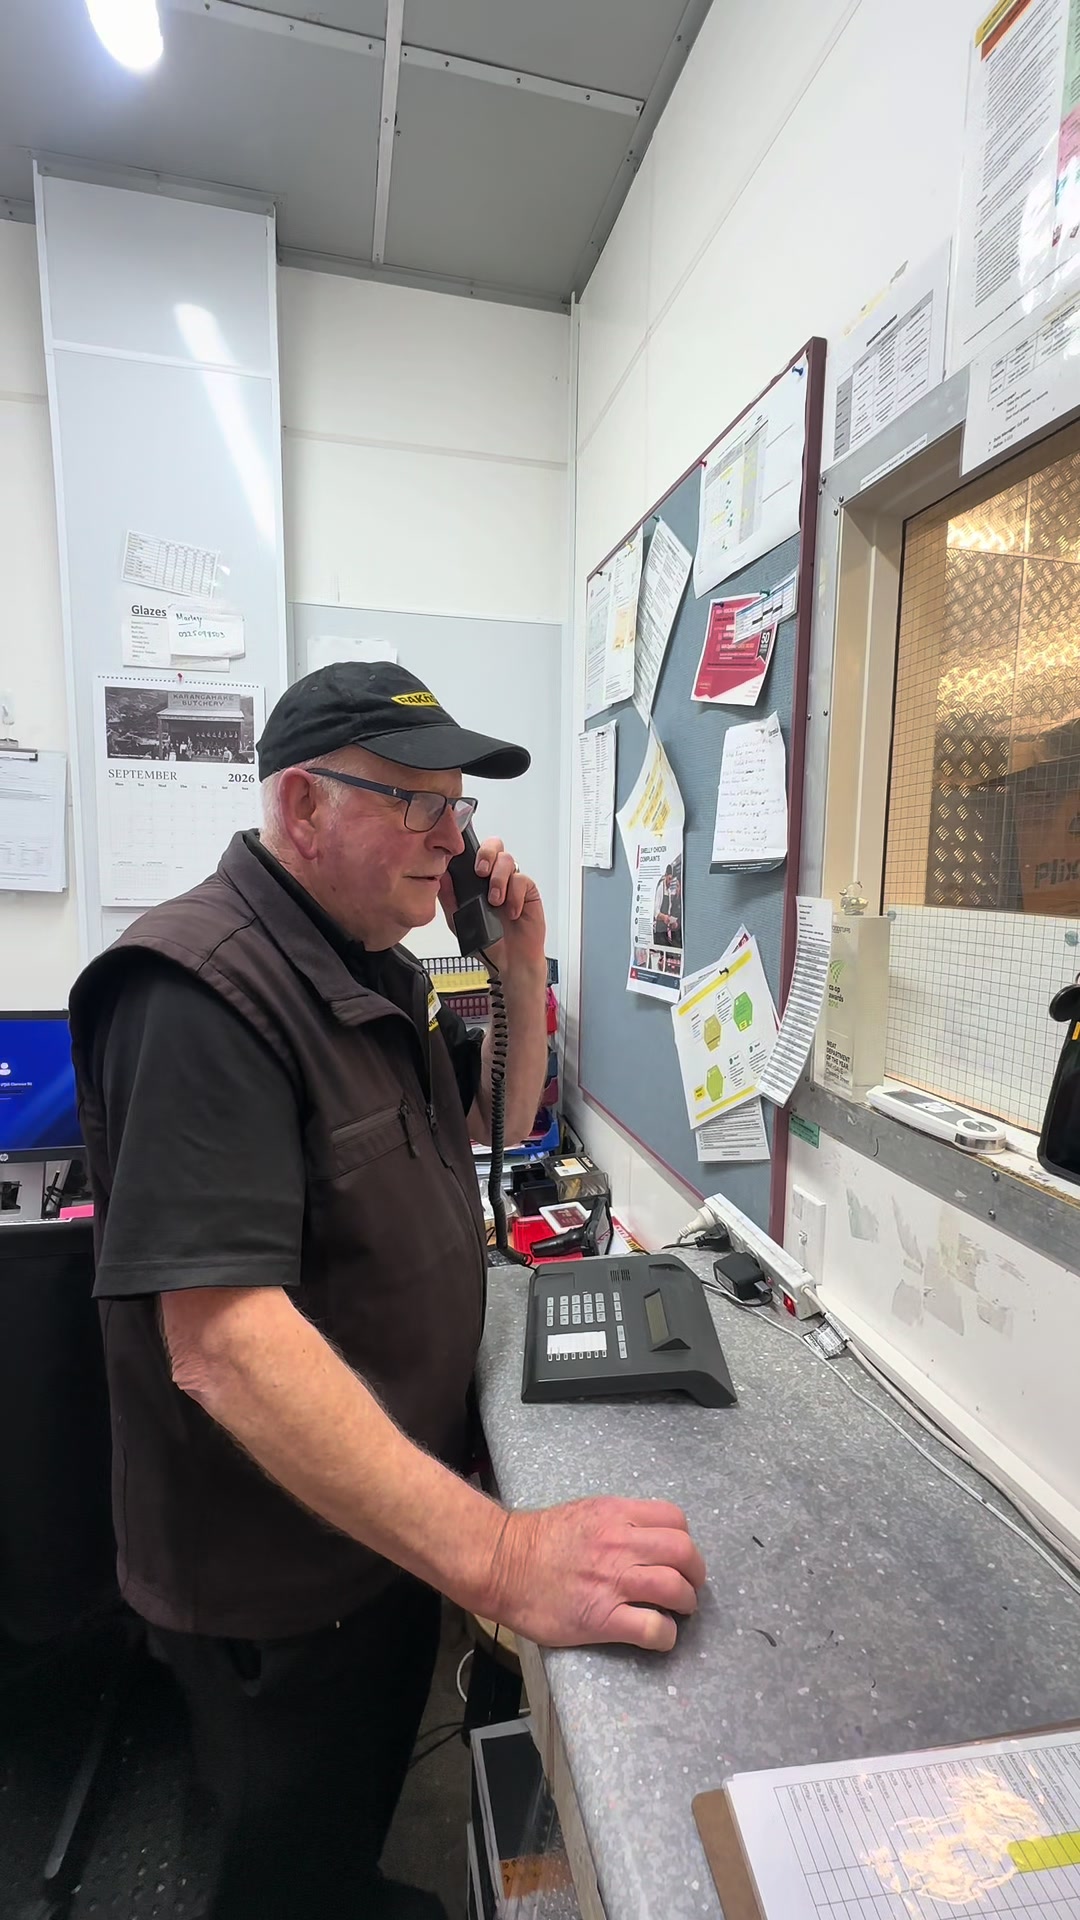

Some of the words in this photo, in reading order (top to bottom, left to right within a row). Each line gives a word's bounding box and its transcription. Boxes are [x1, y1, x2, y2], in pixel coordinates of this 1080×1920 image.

[131, 605, 167, 617] Glazes
[761, 631, 770, 644] 50
[173, 693, 234, 701] KARANGAHAKE
[108, 769, 178, 781] SEPTEMBER
[228, 773, 255, 784] 2026
[826, 1040, 837, 1049] MEAT
[826, 1047, 851, 1063] DEPARTMENT
[826, 1053, 832, 1061] OF
[831, 1056, 839, 1065] THE
[839, 1059, 849, 1070] YEAR
[789, 1786, 802, 1812] Venison
[801, 1784, 812, 1801] Offal
[815, 1782, 823, 1794] Rib
[819, 1793, 830, 1813] Roast
[852, 1777, 862, 1797] Gravy
[860, 1797, 871, 1812] Beef
